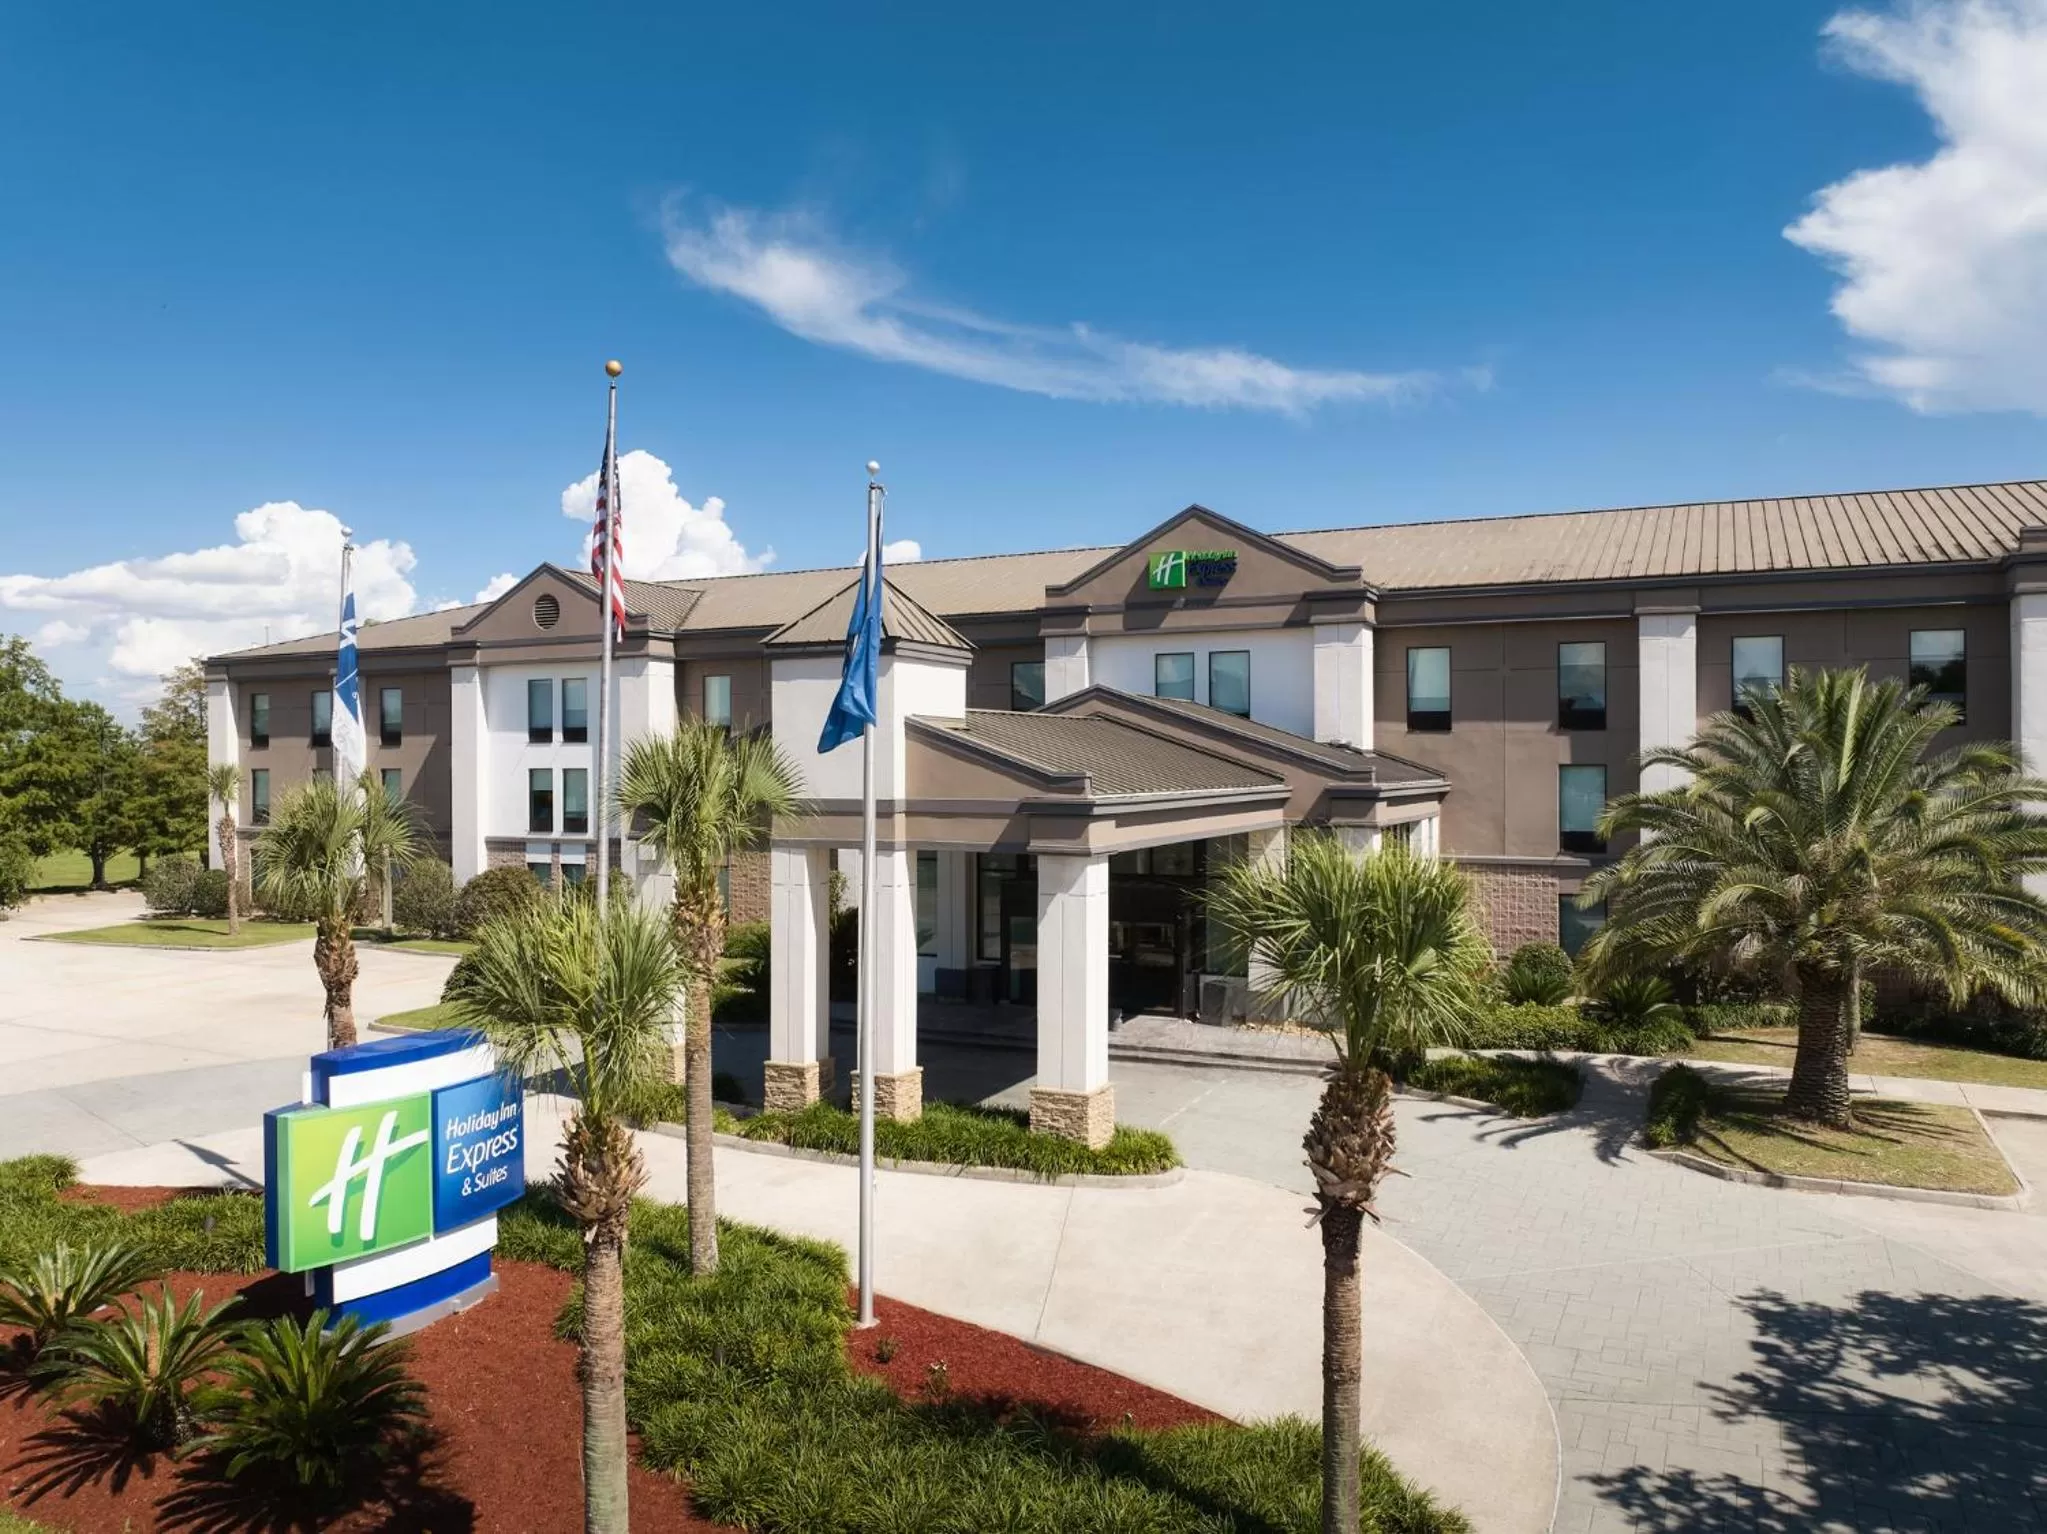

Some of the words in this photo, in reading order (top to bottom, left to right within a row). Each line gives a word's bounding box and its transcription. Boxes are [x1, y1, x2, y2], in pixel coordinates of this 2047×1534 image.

[446, 1108, 500, 1140] Holiday
[500, 1101, 517, 1121] Inn
[446, 1127, 518, 1174] Express
[461, 1176, 472, 1197] &
[474, 1165, 508, 1193] Suites
